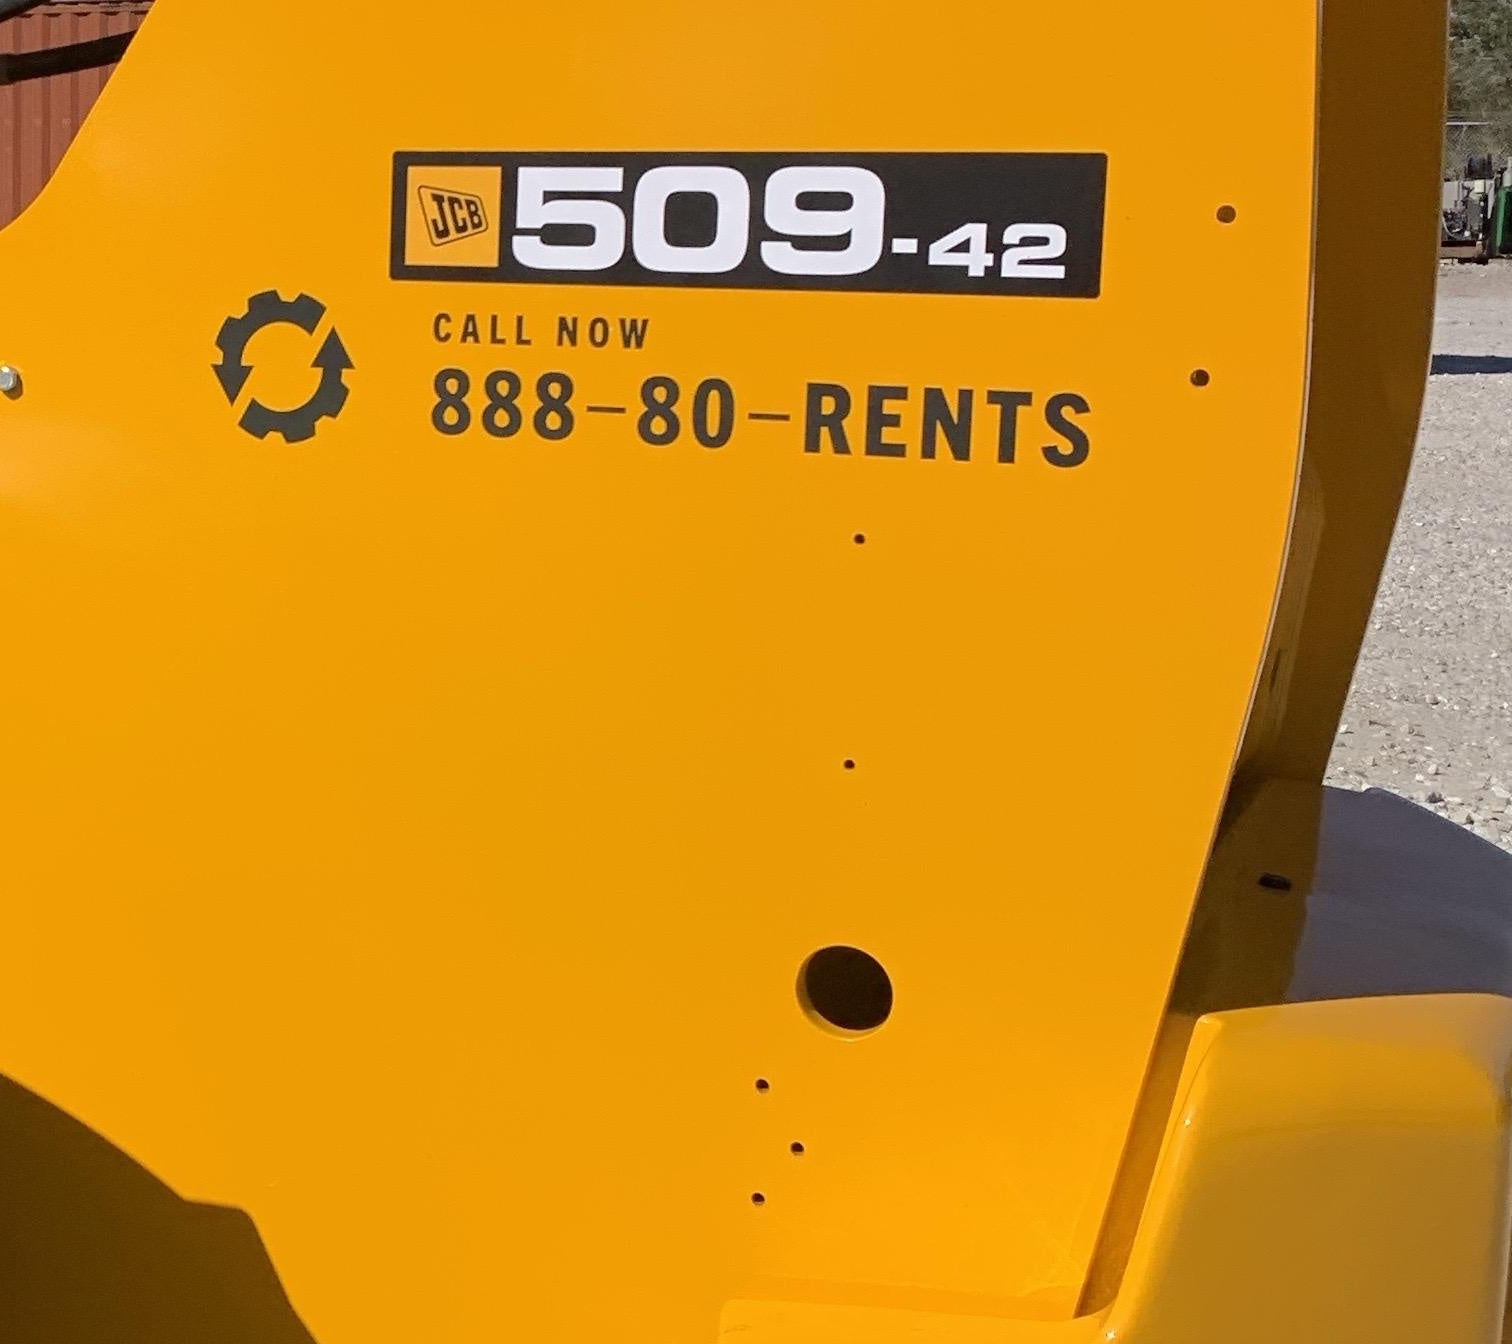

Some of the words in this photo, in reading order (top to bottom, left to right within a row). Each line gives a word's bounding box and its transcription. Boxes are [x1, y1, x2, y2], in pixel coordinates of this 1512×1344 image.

[430, 192, 484, 240] JCB
[511, 165, 1068, 280] 509-42
[432, 312, 533, 347] CALL
[555, 316, 650, 351] NOW
[431, 367, 1092, 469] 888-80-RENTS
